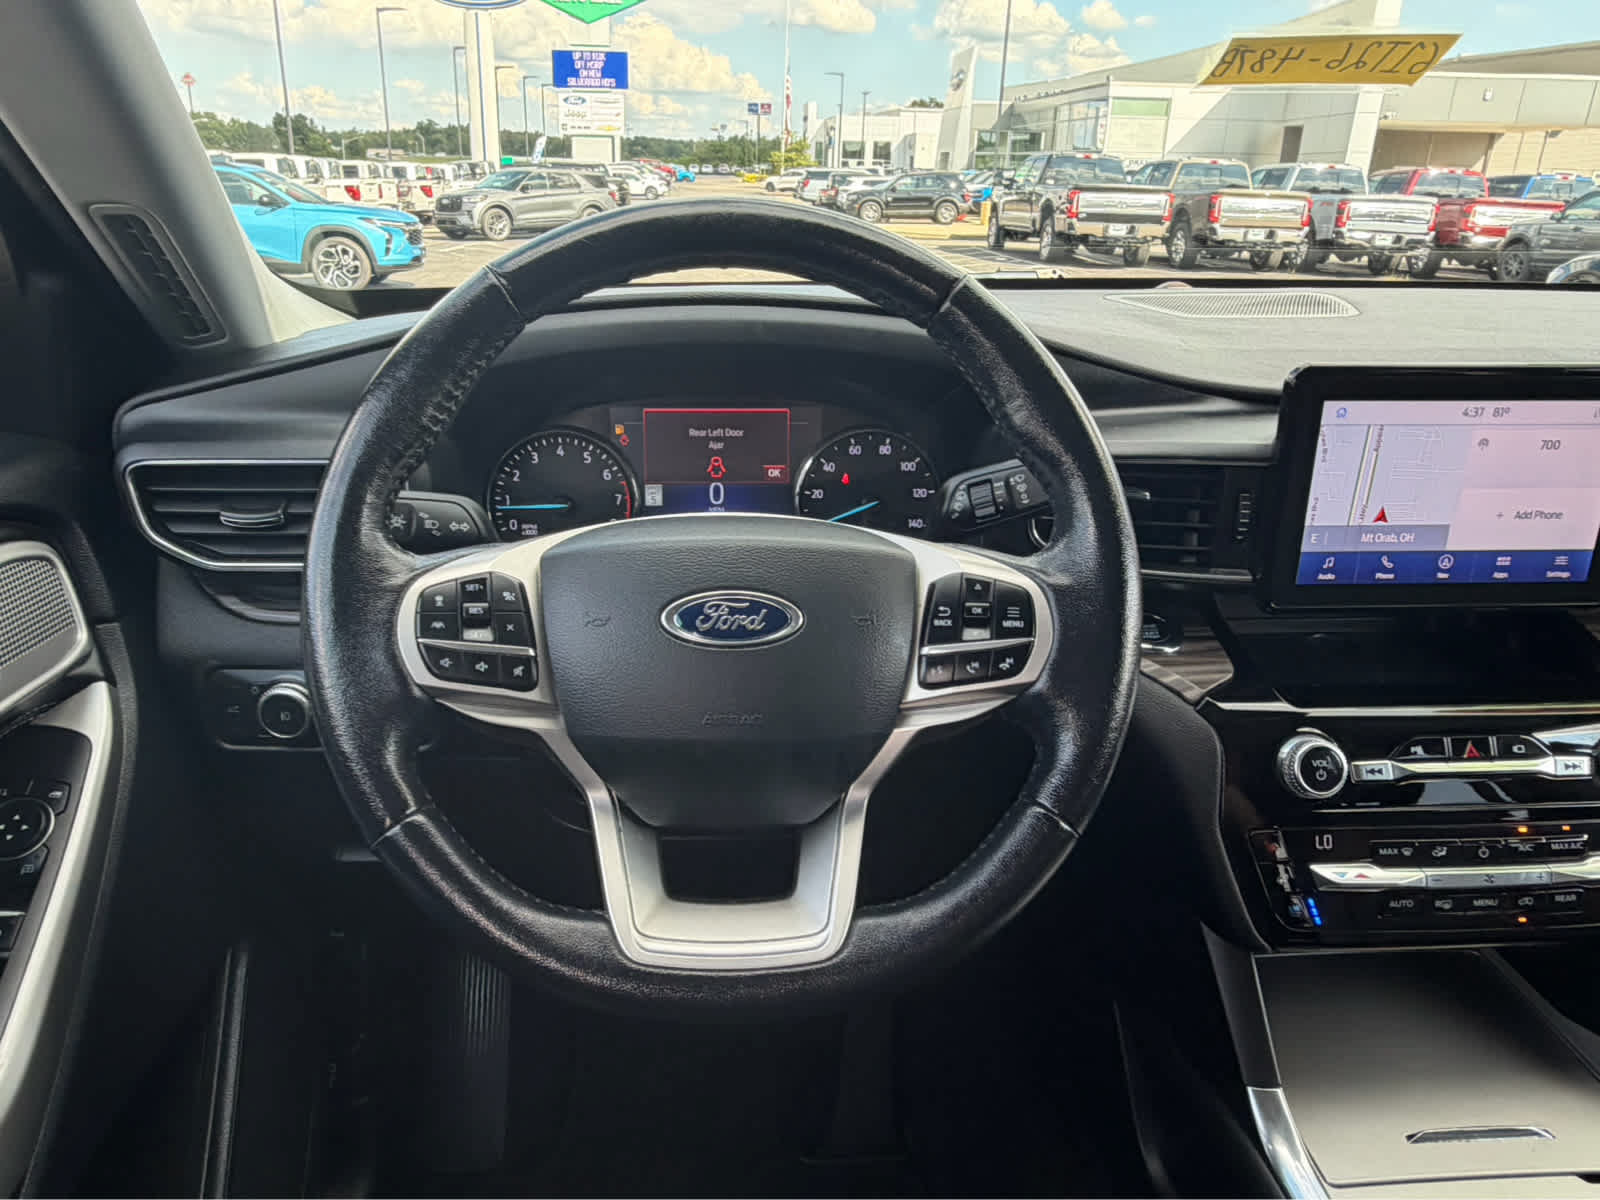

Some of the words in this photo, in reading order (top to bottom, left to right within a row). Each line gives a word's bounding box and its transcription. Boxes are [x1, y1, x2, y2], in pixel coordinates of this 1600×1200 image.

[1462, 406, 1485, 418] 4:37
[689, 428, 706, 437] Rear
[708, 428, 724, 437] Left
[725, 428, 744, 437] Door
[708, 441, 724, 450] Ajar
[1540, 439, 1561, 450] 700
[556, 445, 565, 457] 4
[849, 445, 862, 455] 60
[879, 445, 892, 455] 80
[531, 451, 539, 464] 3
[583, 451, 592, 464] 5
[823, 462, 835, 472] 40
[900, 461, 916, 472] 100
[512, 470, 520, 482] 2
[602, 469, 612, 480] 6
[768, 468, 781, 477] OK
[709, 482, 724, 505] 0
[811, 488, 824, 499] 20
[912, 488, 928, 498] 120
[505, 494, 511, 506] 1
[615, 493, 623, 505] 7
[1514, 510, 1532, 520] Add
[1533, 510, 1563, 520] Phone
[509, 519, 518, 530] 0
[908, 518, 923, 529] 140
[1311, 533, 1319, 544] E
[1361, 533, 1374, 543] Mt
[1399, 533, 1416, 543] OH
[1545, 571, 1571, 580] Settings
[695, 600, 768, 632] Ford
[933, 619, 953, 627] BACK
[1002, 620, 1025, 628] MENU
[1311, 759, 1329, 768] VOL
[1315, 834, 1333, 849] LO
[1551, 842, 1568, 850] MAX
[1473, 898, 1498, 907] MENU
[1555, 894, 1577, 903] REAR
[1389, 900, 1415, 909] AUTO
